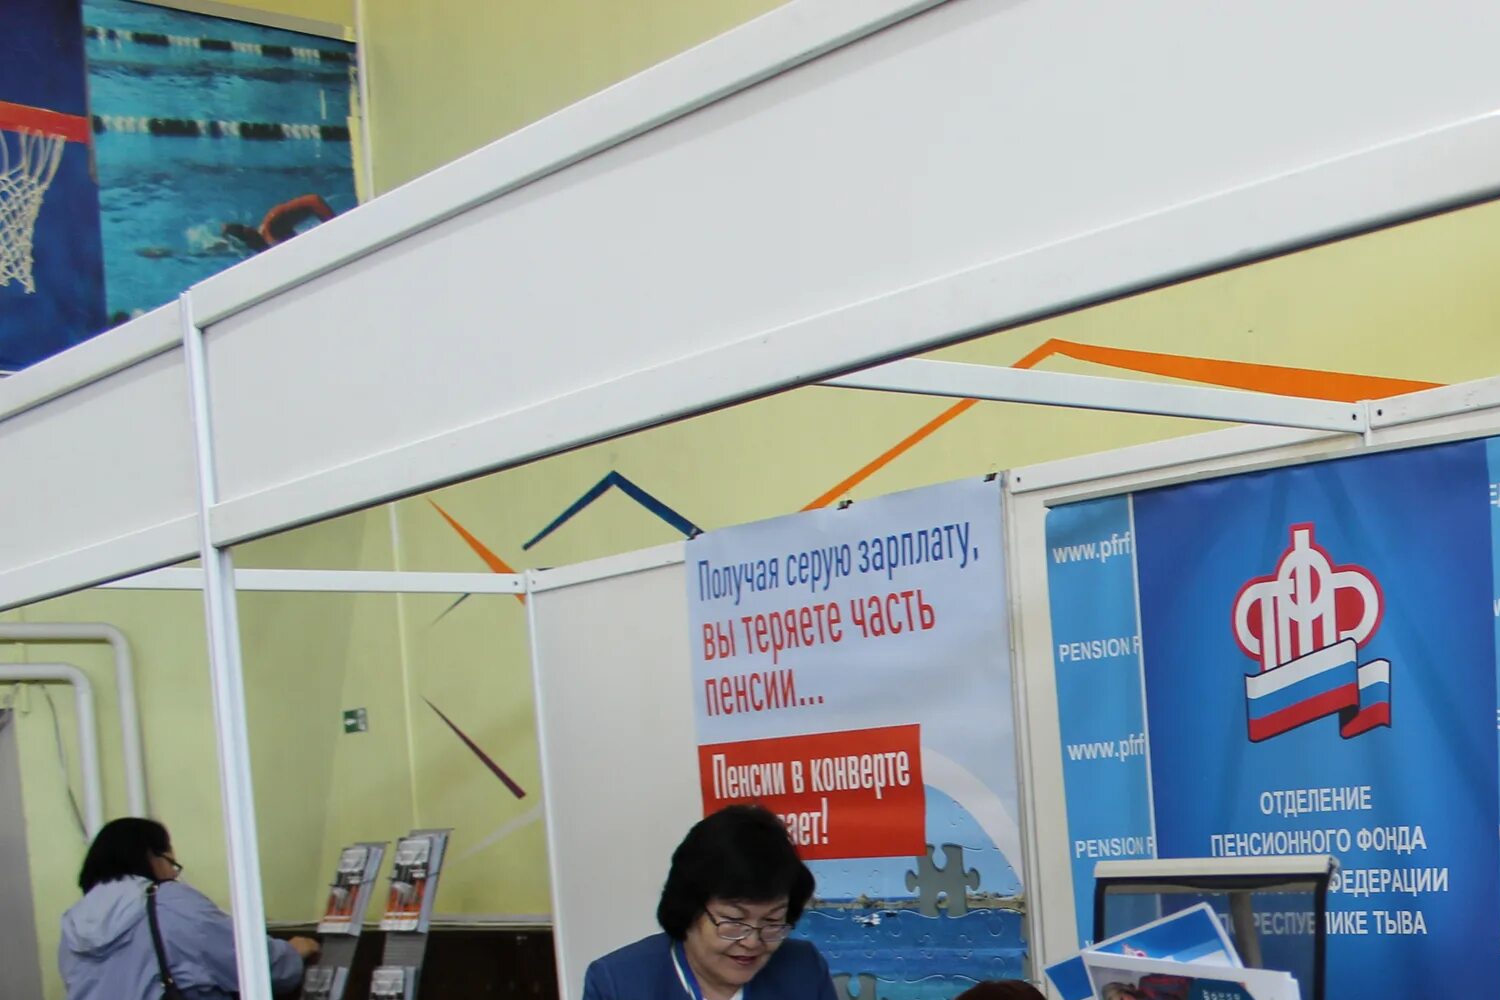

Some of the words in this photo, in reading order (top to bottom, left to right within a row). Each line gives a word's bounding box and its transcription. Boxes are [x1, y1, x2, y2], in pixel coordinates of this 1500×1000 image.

[698, 558, 780, 605] Получая
[786, 542, 850, 593] серую
[858, 521, 979, 580] зарплату,
[703, 620, 736, 661] вы
[742, 601, 842, 664] теряете
[851, 589, 936, 638] часть
[1059, 637, 1131, 663] PENSION
[705, 668, 825, 716] пенсии...
[712, 754, 787, 799] Пенсии
[791, 761, 804, 794] в
[810, 751, 910, 800] конверте
[776, 797, 829, 846] ает!
[1260, 785, 1372, 818] ОТДЕЛЕНИЕ
[1075, 836, 1144, 858] PENSION
[1211, 828, 1351, 858] ПЕНСИОННОГО
[1357, 826, 1427, 855] ФОНДА
[1373, 910, 1428, 935] ТЫВА
